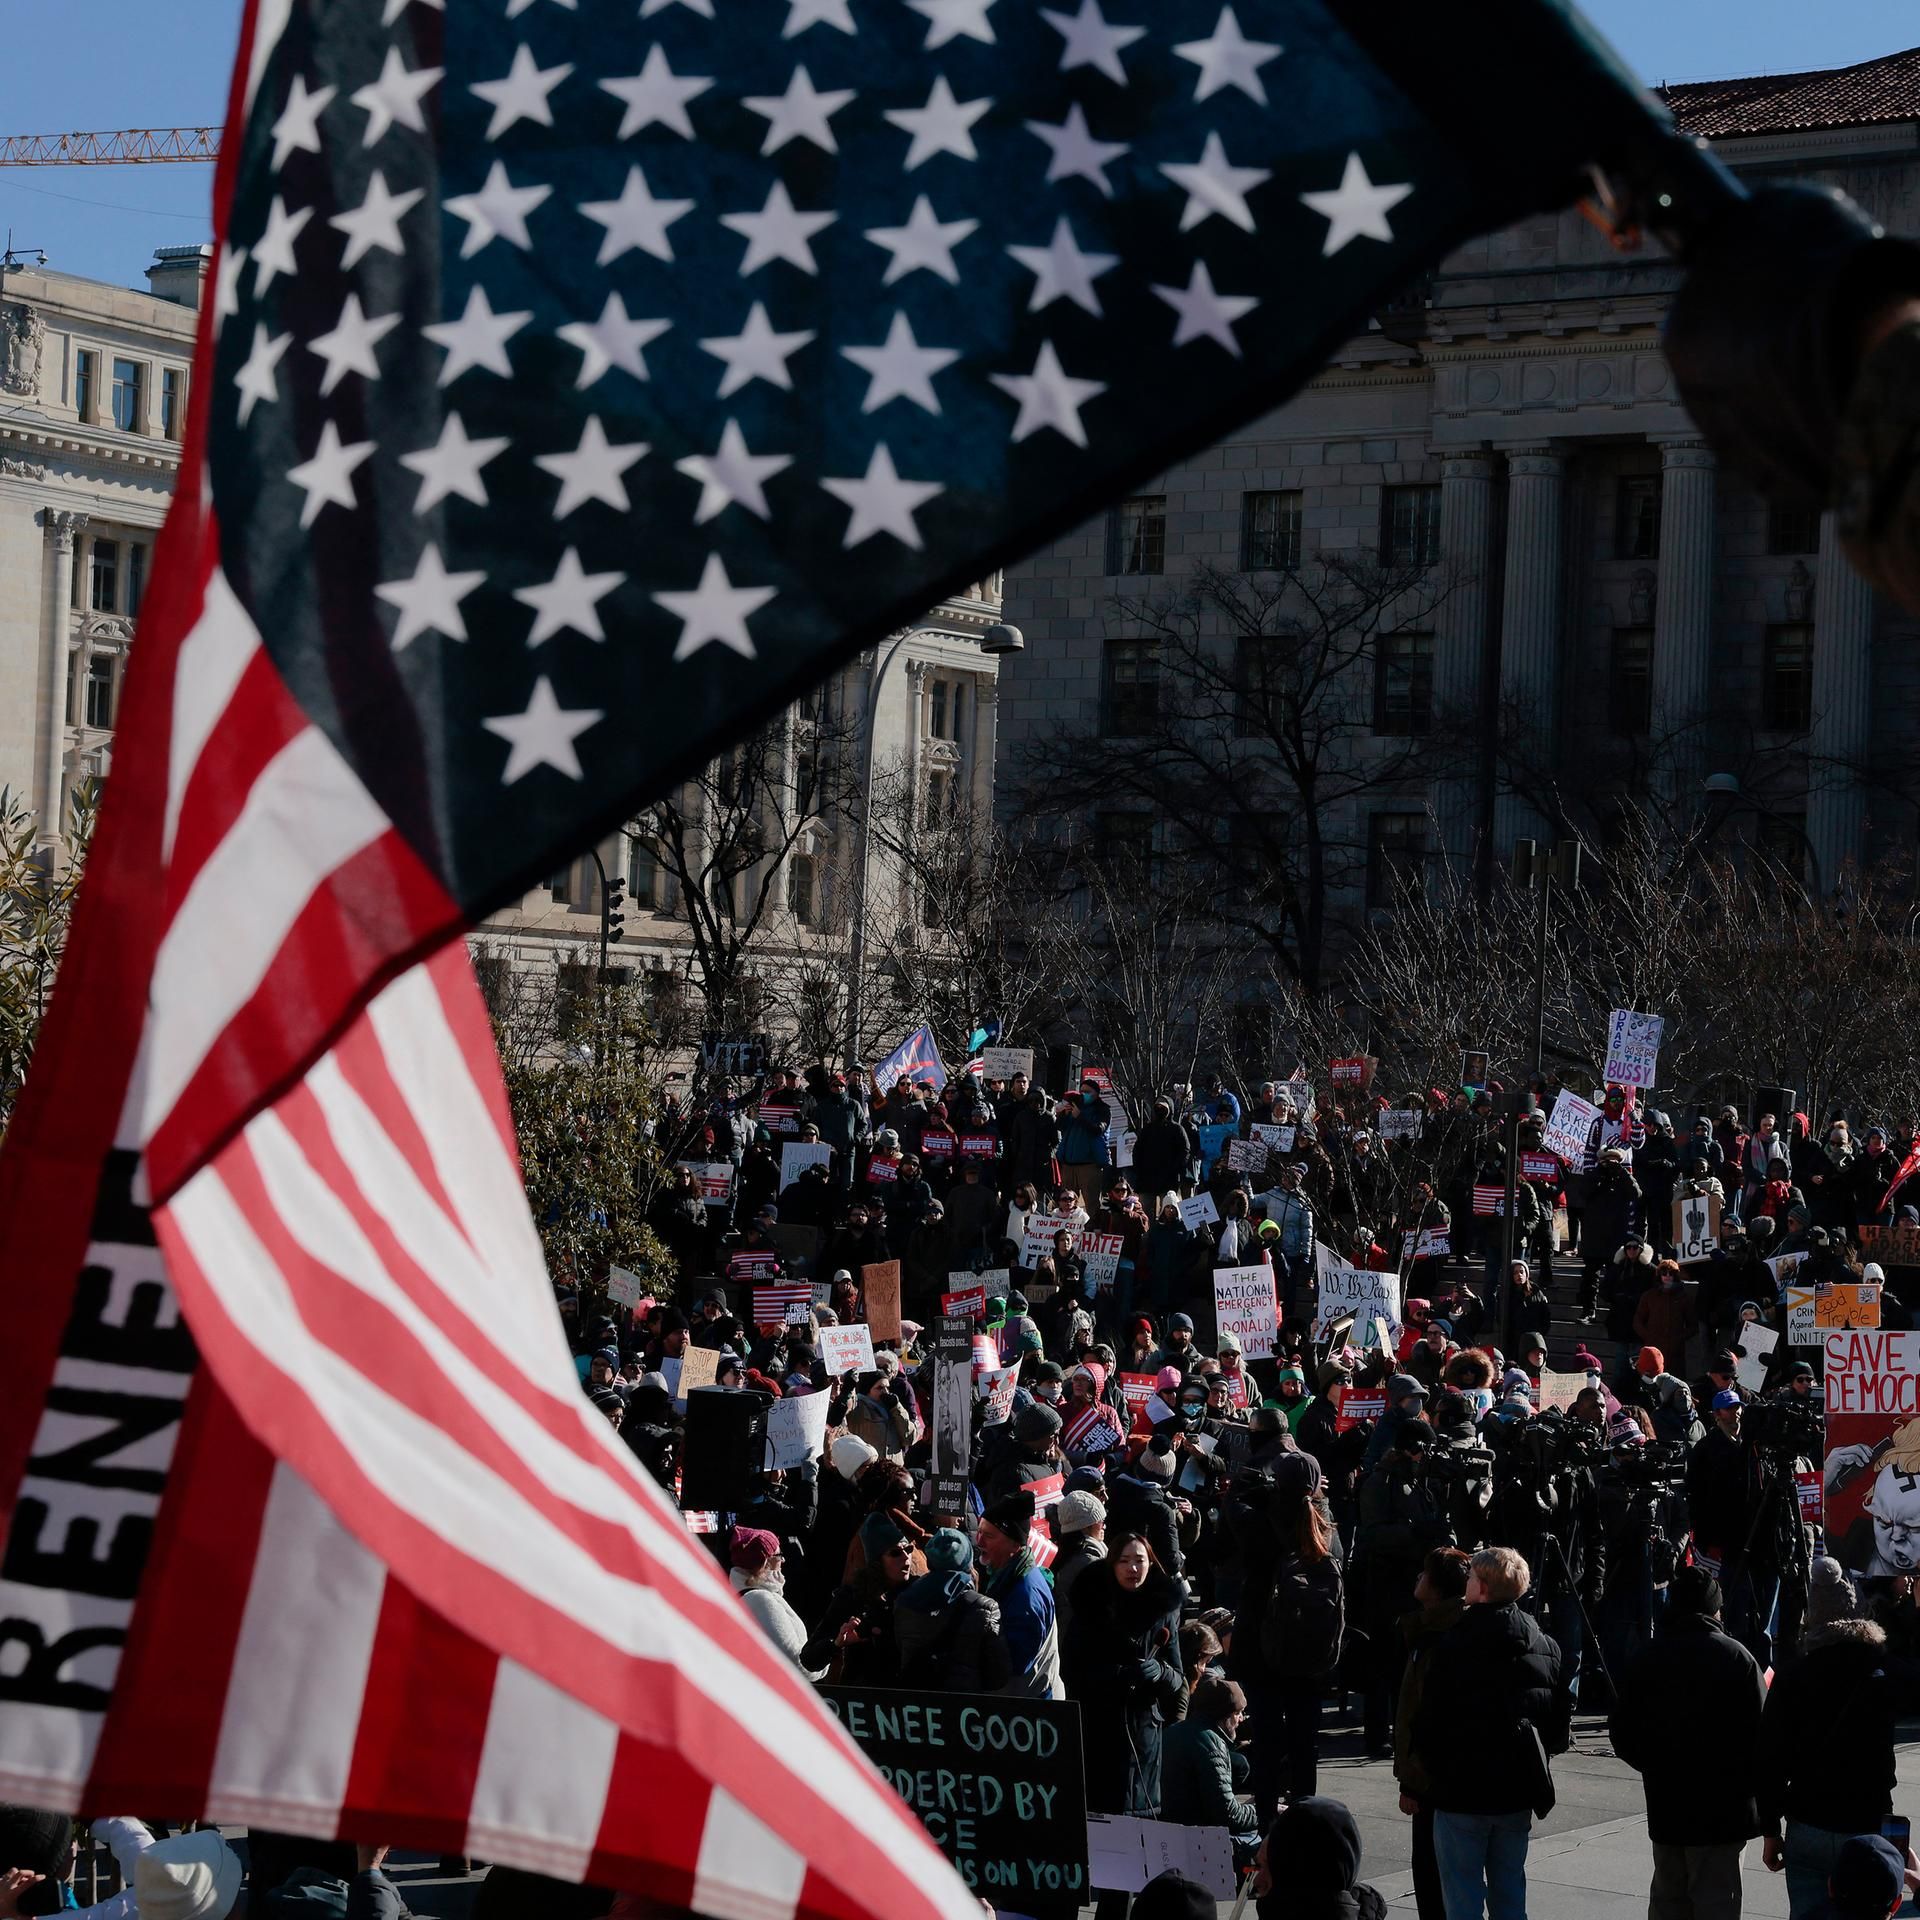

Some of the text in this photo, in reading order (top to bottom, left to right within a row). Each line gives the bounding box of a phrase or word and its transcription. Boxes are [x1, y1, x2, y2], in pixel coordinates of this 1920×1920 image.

[1613, 1011, 1656, 1058] DRAG HIM
[1625, 1055, 1651, 1066] THE
[1607, 1060, 1652, 1085] BUSSY
[1556, 1105, 1589, 1131] MAKE
[1546, 1125, 1586, 1156] WRONG
[711, 1188, 729, 1199] DC
[1036, 1219, 1048, 1227] YOU
[1081, 1233, 1124, 1255] HATE
[1682, 1238, 1713, 1259] ICE
[1091, 1268, 1113, 1281] RICA
[1232, 1272, 1257, 1284] THE
[1216, 1283, 1272, 1299] NATIONAL
[1325, 1272, 1345, 1295] We
[1343, 1272, 1367, 1300] The
[947, 1303, 983, 1316] FREE DC
[1218, 1296, 1273, 1310] EMERGENCY
[1816, 1290, 1847, 1313] Good
[1243, 1307, 1253, 1317] IS
[1324, 1305, 1347, 1318] can
[1369, 1304, 1391, 1322] this
[1823, 1307, 1870, 1328] Trouble
[943, 1319, 950, 1331] We
[950, 1319, 959, 1331] beat
[1223, 1318, 1271, 1333] DONALD
[939, 1336, 956, 1347] fascists
[1240, 1337, 1275, 1354] UMP
[692, 1351, 713, 1367] STOP
[1826, 1333, 1905, 1372] SAVE
[1123, 1391, 1141, 1400] FREE
[1341, 1408, 1384, 1418] FREE DC
[1083, 1423, 1104, 1446] FREE
[939, 1479, 947, 1491] and
[938, 1497, 945, 1509] do
[1806, 1494, 1820, 1504] DC
[960, 1707, 1059, 1757] GOOD
[879, 1765, 1057, 1821] DERED BY
[914, 1812, 977, 1850] CE
[985, 1859, 1018, 1886] ON
[1026, 1859, 1082, 1890] YOU
